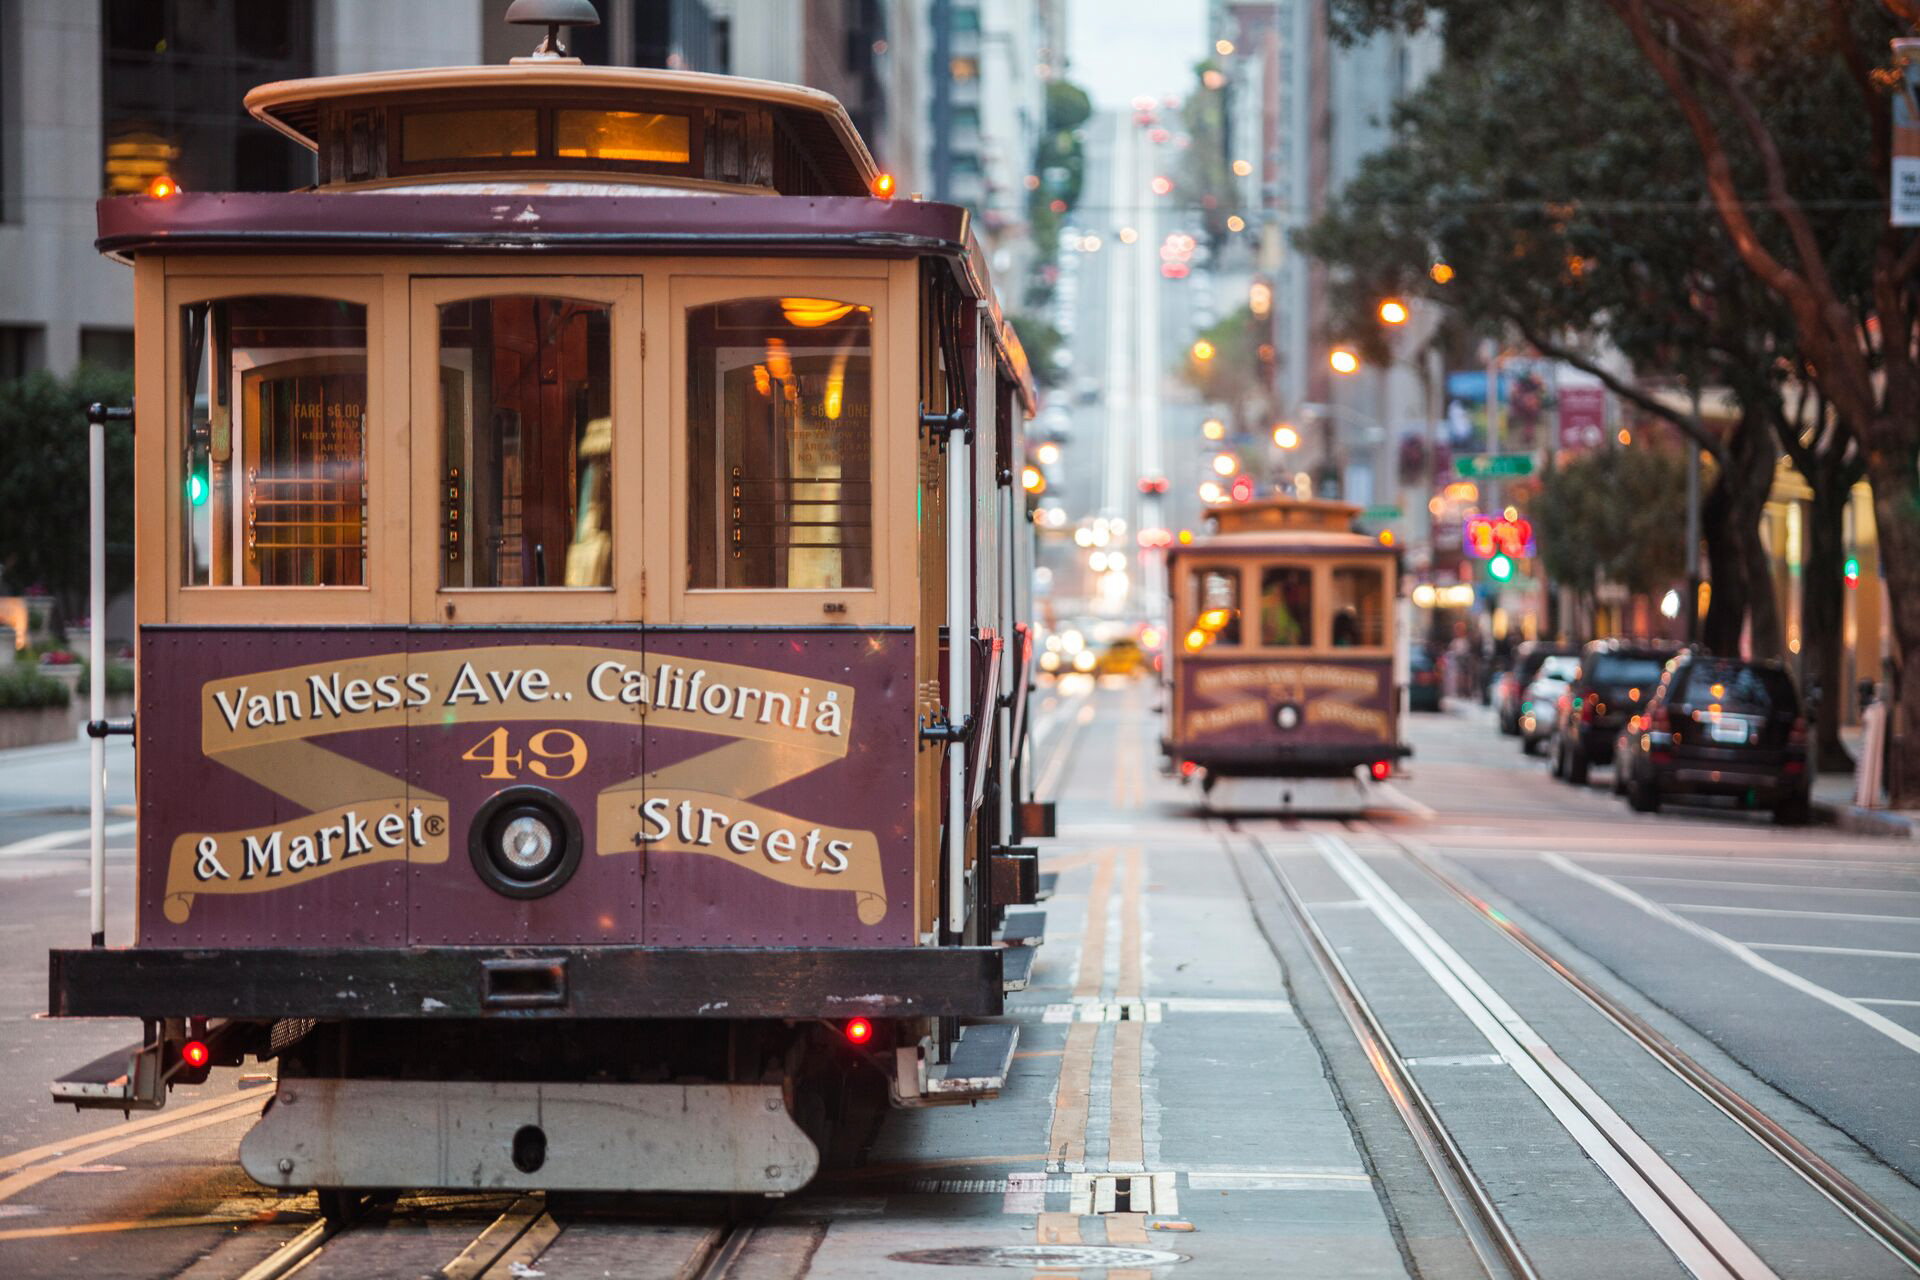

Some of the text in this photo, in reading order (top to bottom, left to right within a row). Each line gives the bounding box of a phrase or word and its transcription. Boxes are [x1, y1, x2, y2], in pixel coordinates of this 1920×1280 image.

[294, 403, 321, 418] FARE
[214, 686, 303, 732] Van
[308, 672, 432, 719] Ness
[588, 660, 842, 736] California
[462, 727, 588, 780] 49
[194, 836, 230, 881] &
[635, 797, 854, 876] Streets
